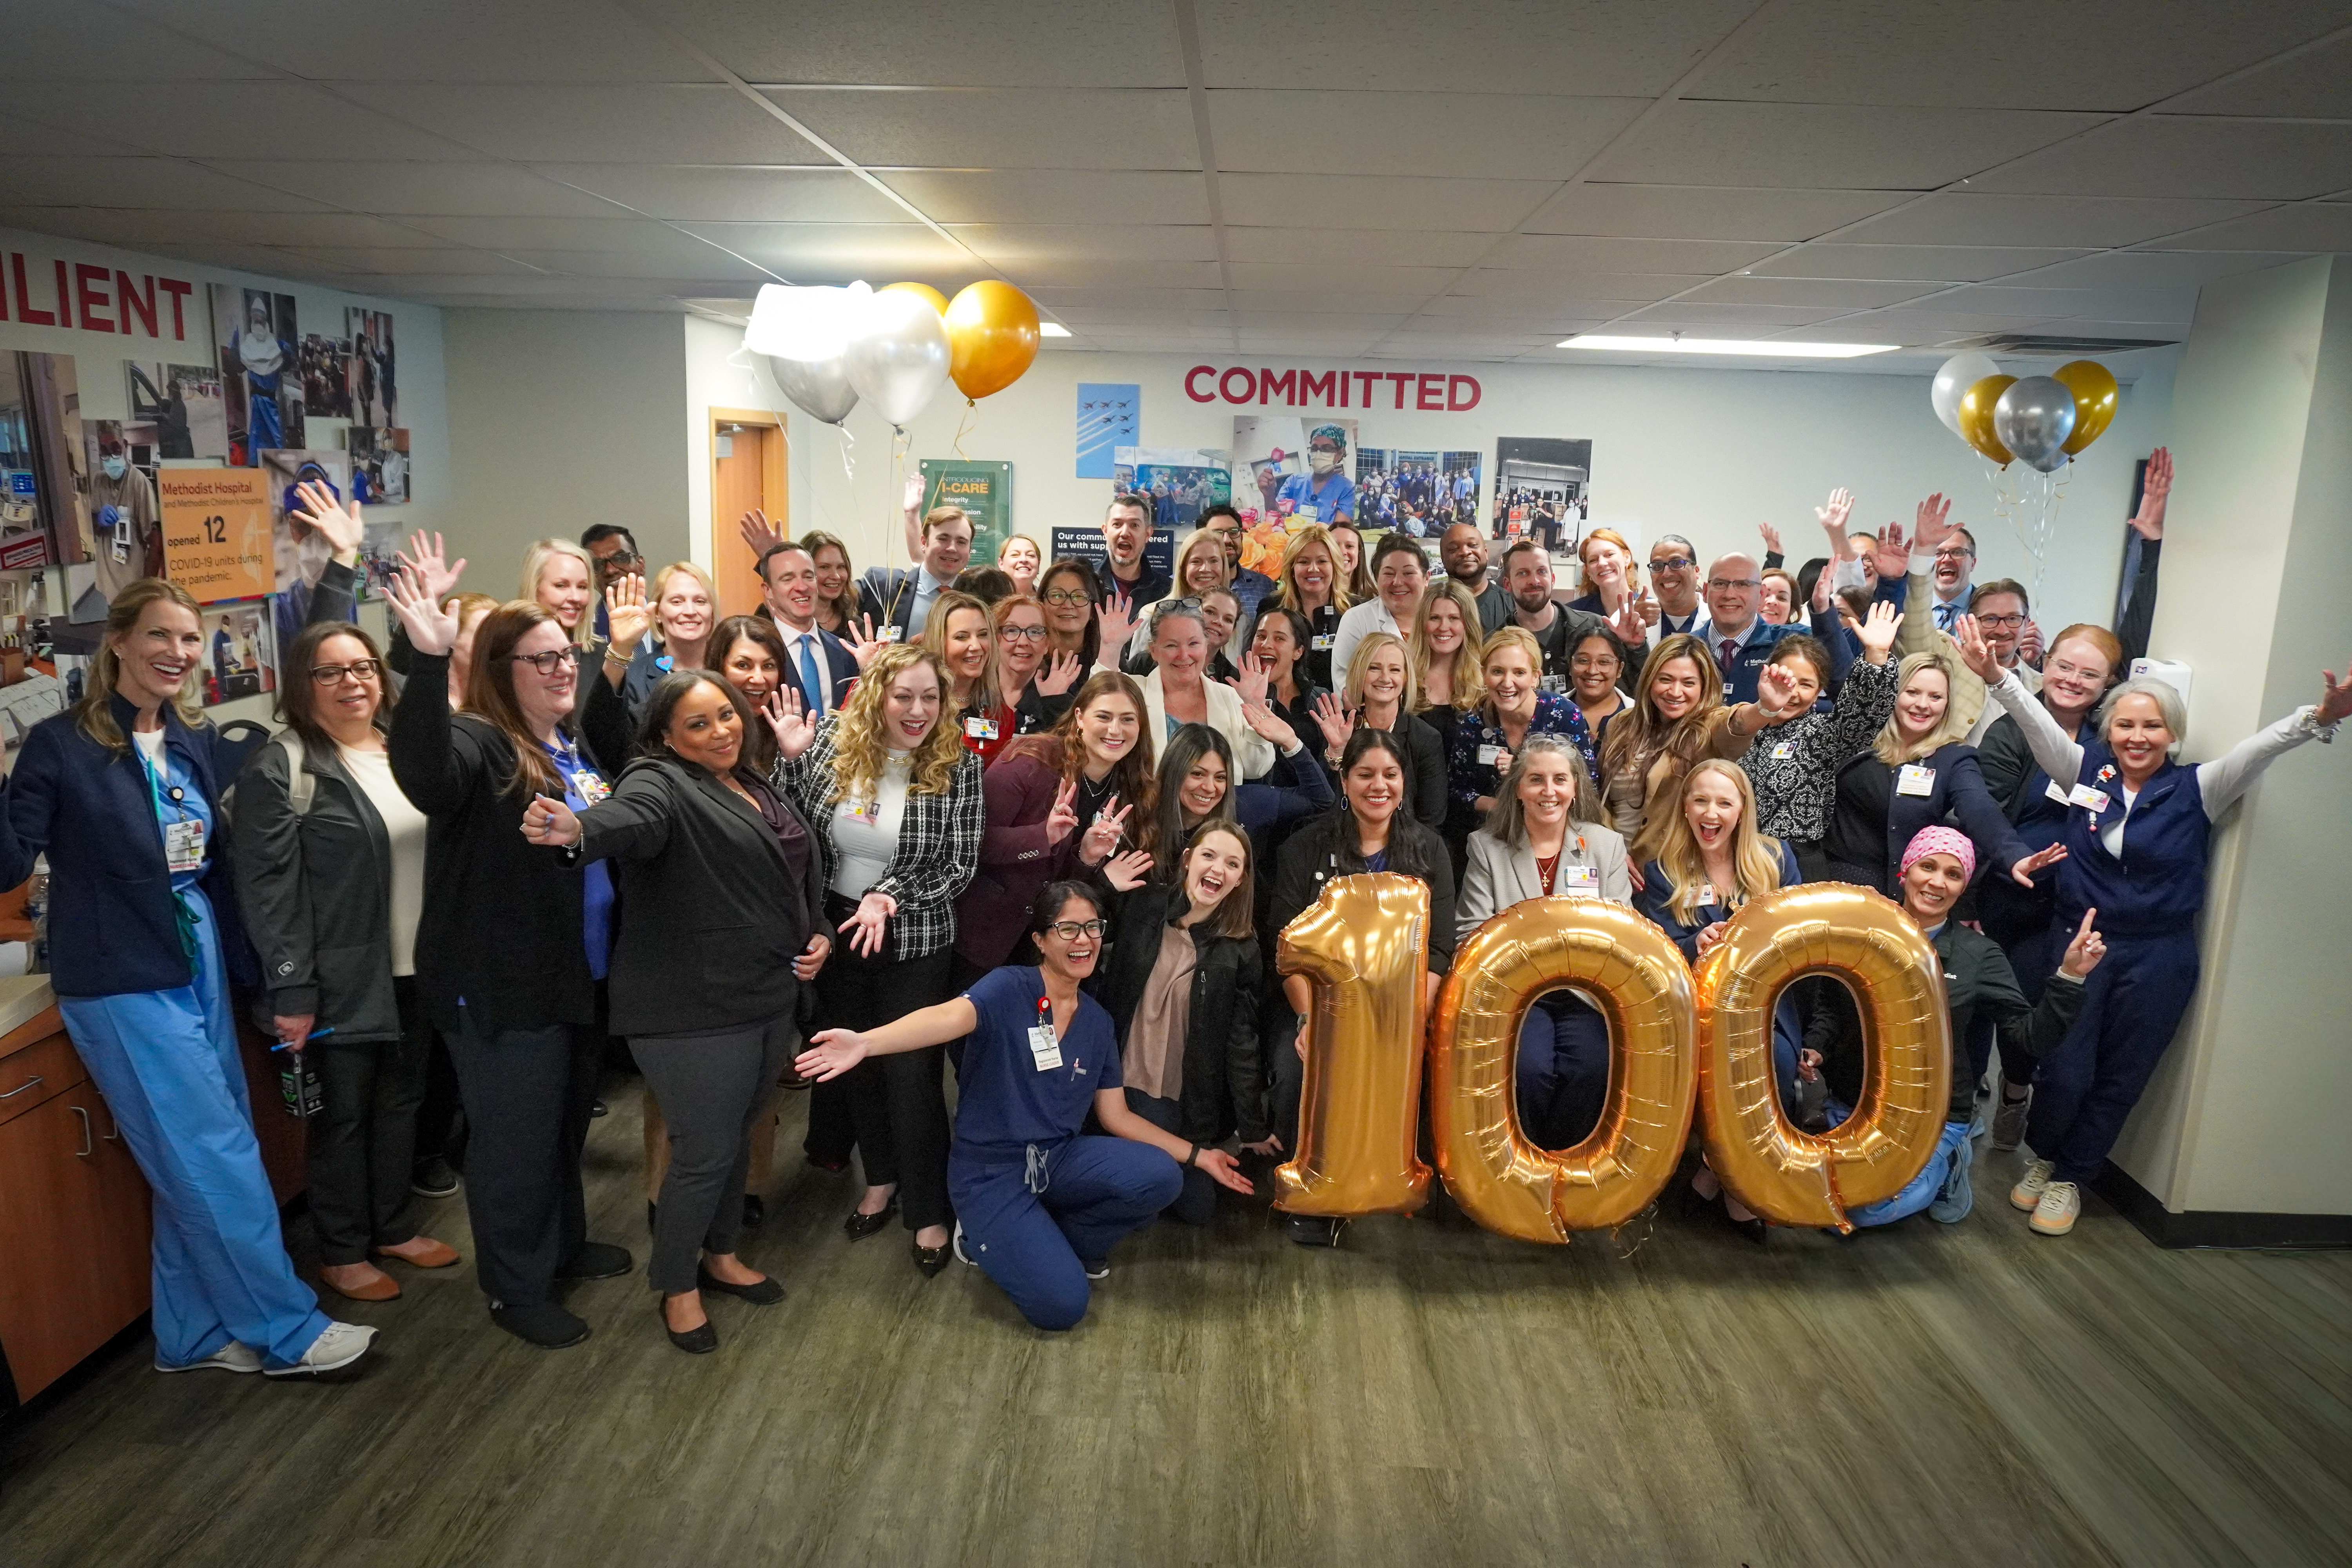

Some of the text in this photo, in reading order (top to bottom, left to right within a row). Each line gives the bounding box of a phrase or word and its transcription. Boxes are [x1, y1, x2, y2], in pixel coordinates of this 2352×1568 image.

[1184, 365, 1482, 412] COMMITTED
[162, 481, 252, 495] Methodist Hospital
[942, 482, 988, 493] I-CARE
[177, 499, 210, 507] Methodist
[240, 497, 263, 505] Hospital
[203, 515, 226, 544] 12
[168, 534, 200, 549] opened
[169, 554, 263, 571] COVID-19 units during
[189, 570, 232, 587] pandemic.
